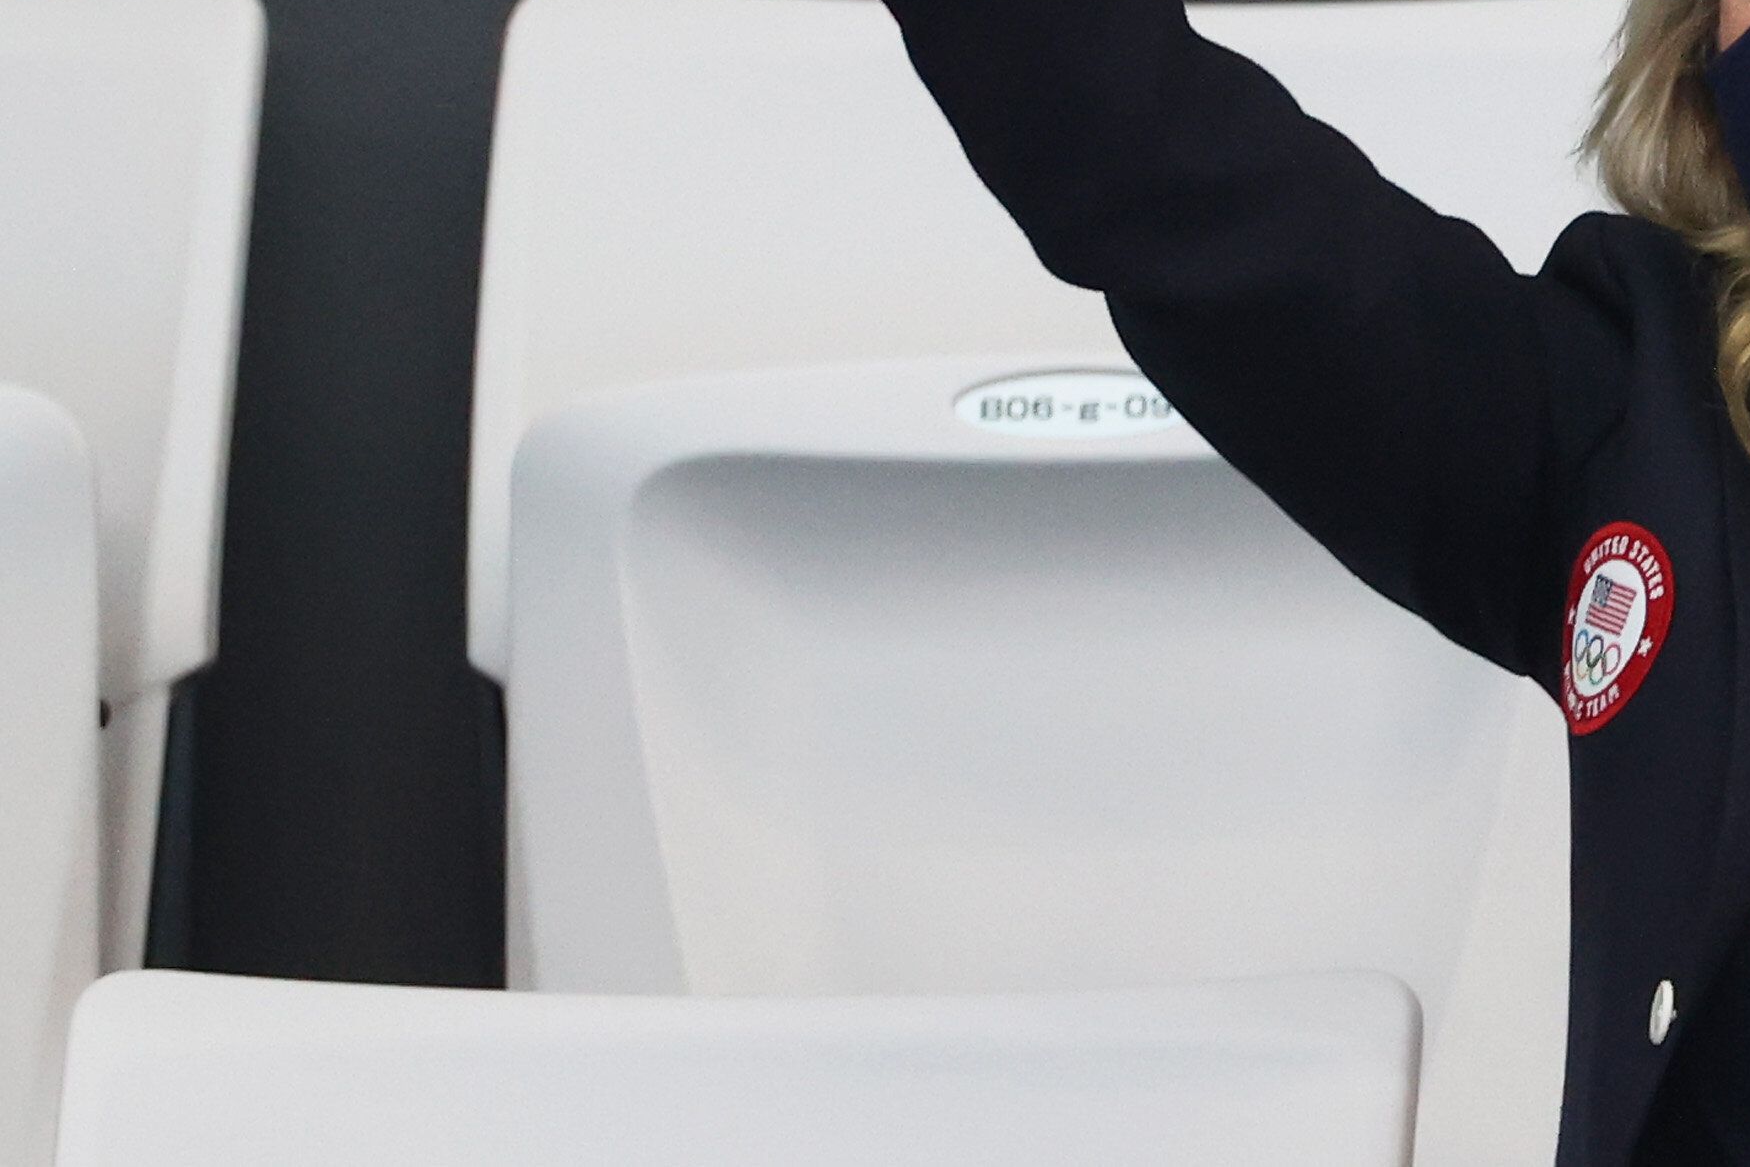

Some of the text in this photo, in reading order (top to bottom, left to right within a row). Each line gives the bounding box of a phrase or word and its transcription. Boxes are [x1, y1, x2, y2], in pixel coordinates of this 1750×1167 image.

[1583, 535, 1665, 600] UNITED STATES
[1585, 682, 1621, 719] TEAM
